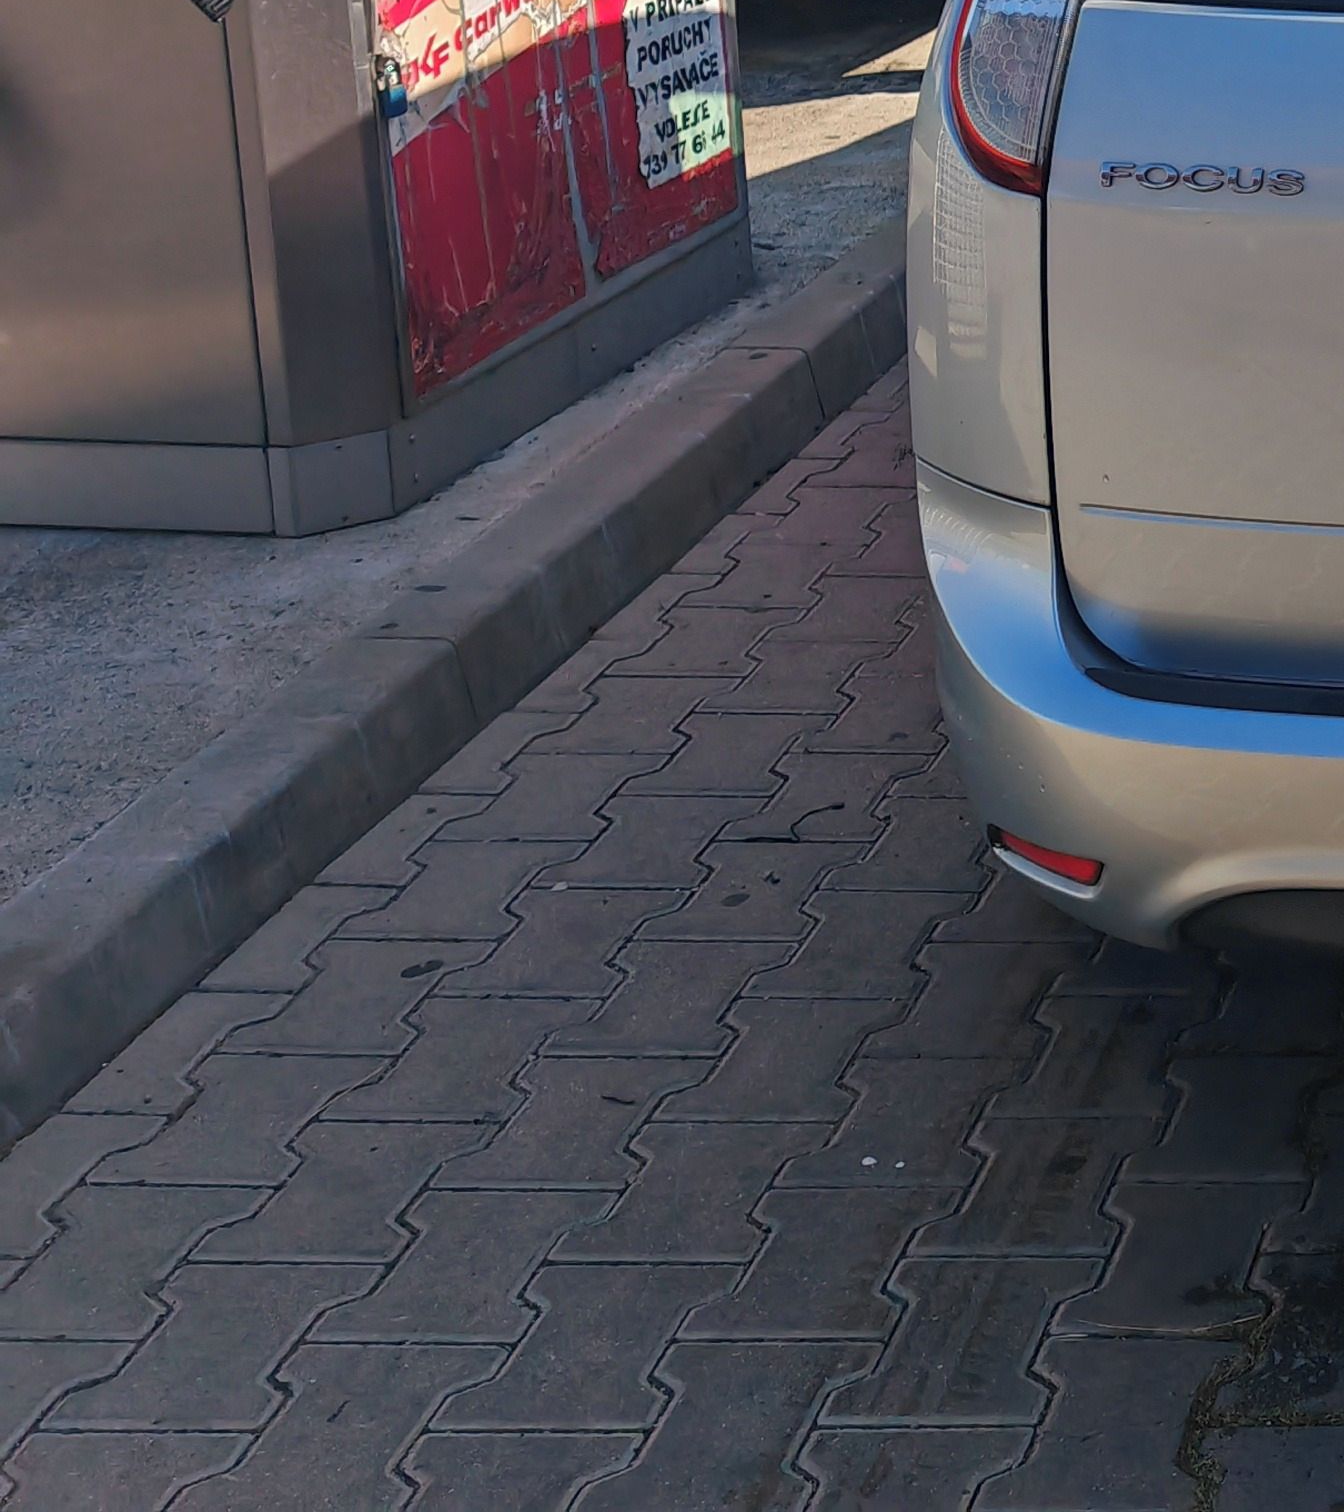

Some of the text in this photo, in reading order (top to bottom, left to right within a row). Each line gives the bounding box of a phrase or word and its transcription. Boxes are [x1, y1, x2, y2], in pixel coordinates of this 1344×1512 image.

[629, 6, 640, 33] V
[637, 16, 712, 72] PORUCHY
[636, 50, 719, 110] VYSAVAČE
[1101, 161, 1305, 197] FOCUS
